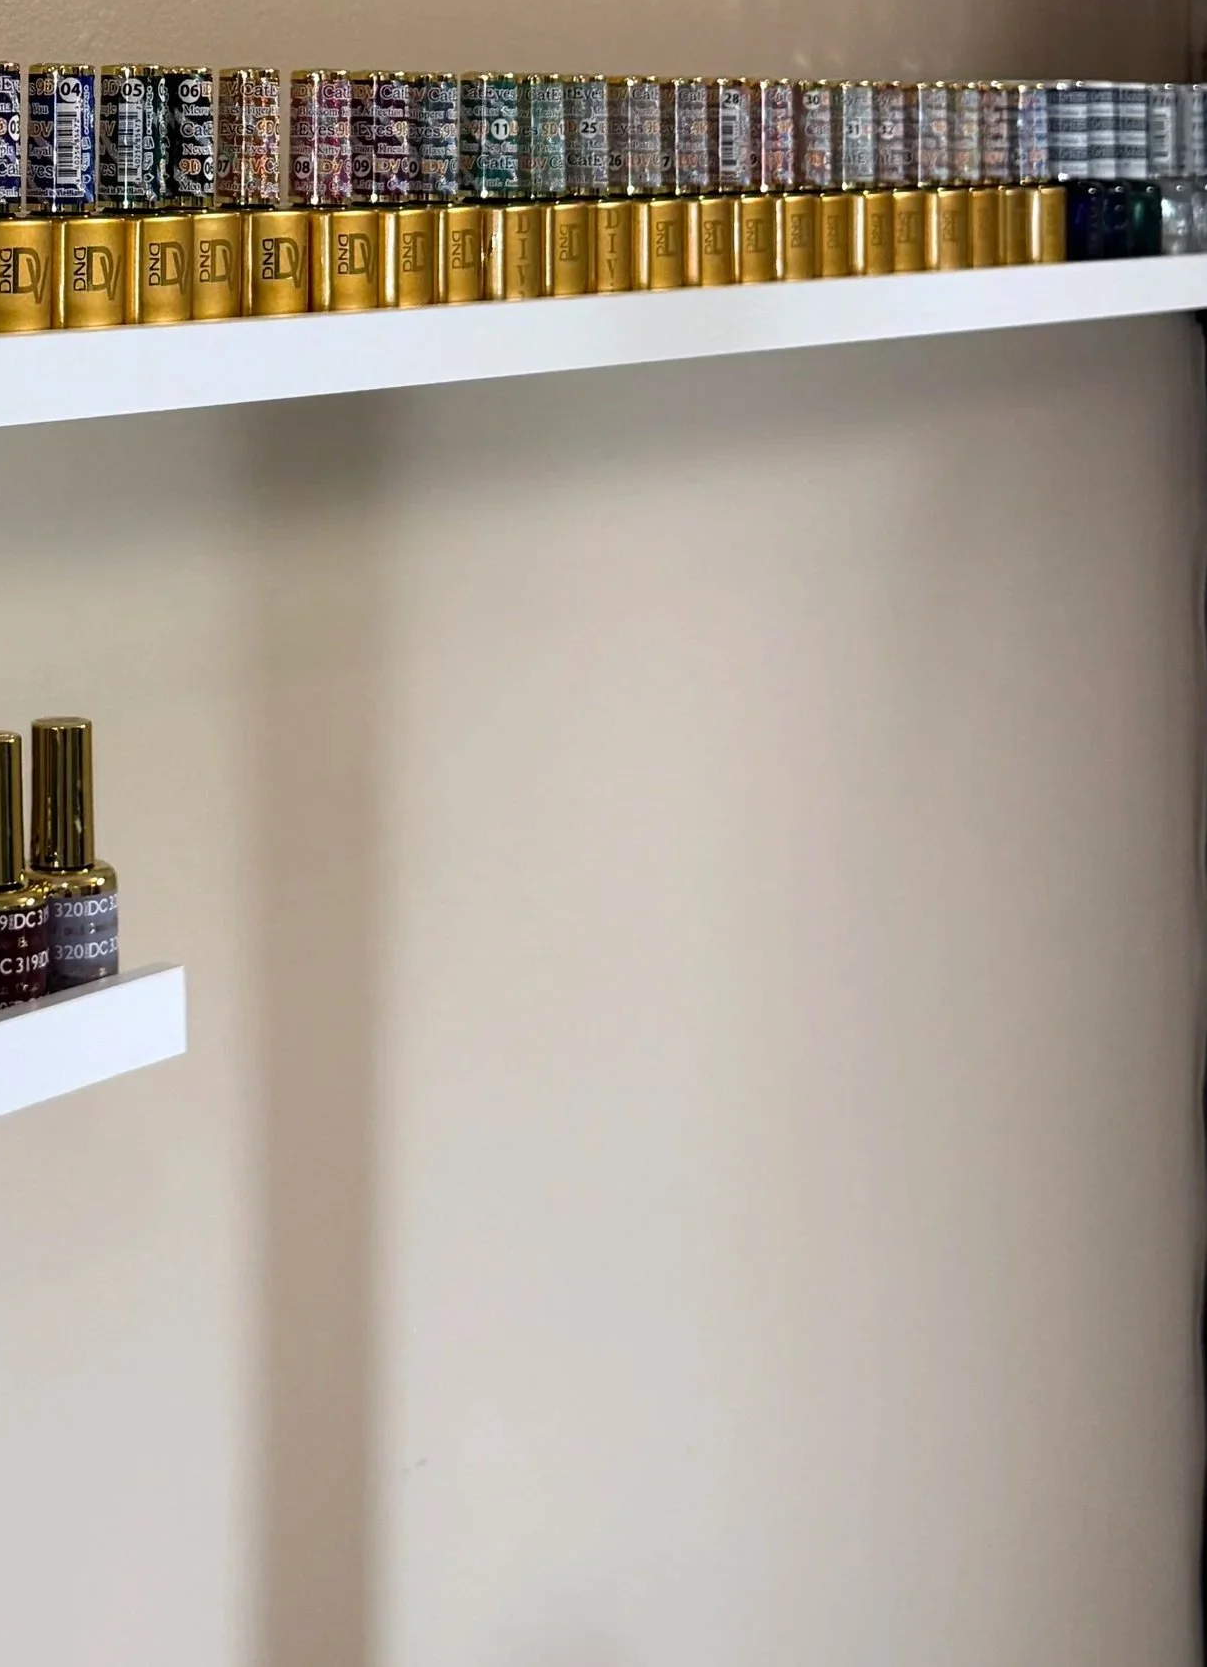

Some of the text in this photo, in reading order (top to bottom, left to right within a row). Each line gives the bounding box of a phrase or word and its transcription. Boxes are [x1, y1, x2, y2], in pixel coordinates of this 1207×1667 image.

[61, 83, 80, 96] 04
[123, 84, 142, 97] 05
[180, 84, 199, 97] 06
[724, 93, 739, 104] 28
[493, 122, 507, 135] 11
[581, 122, 597, 132] 25
[294, 161, 310, 173] 08
[354, 159, 369, 172] 09
[54, 903, 83, 917] 320
[15, 911, 36, 928] DC
[54, 946, 83, 960] 320
[16, 953, 40, 972] 319
